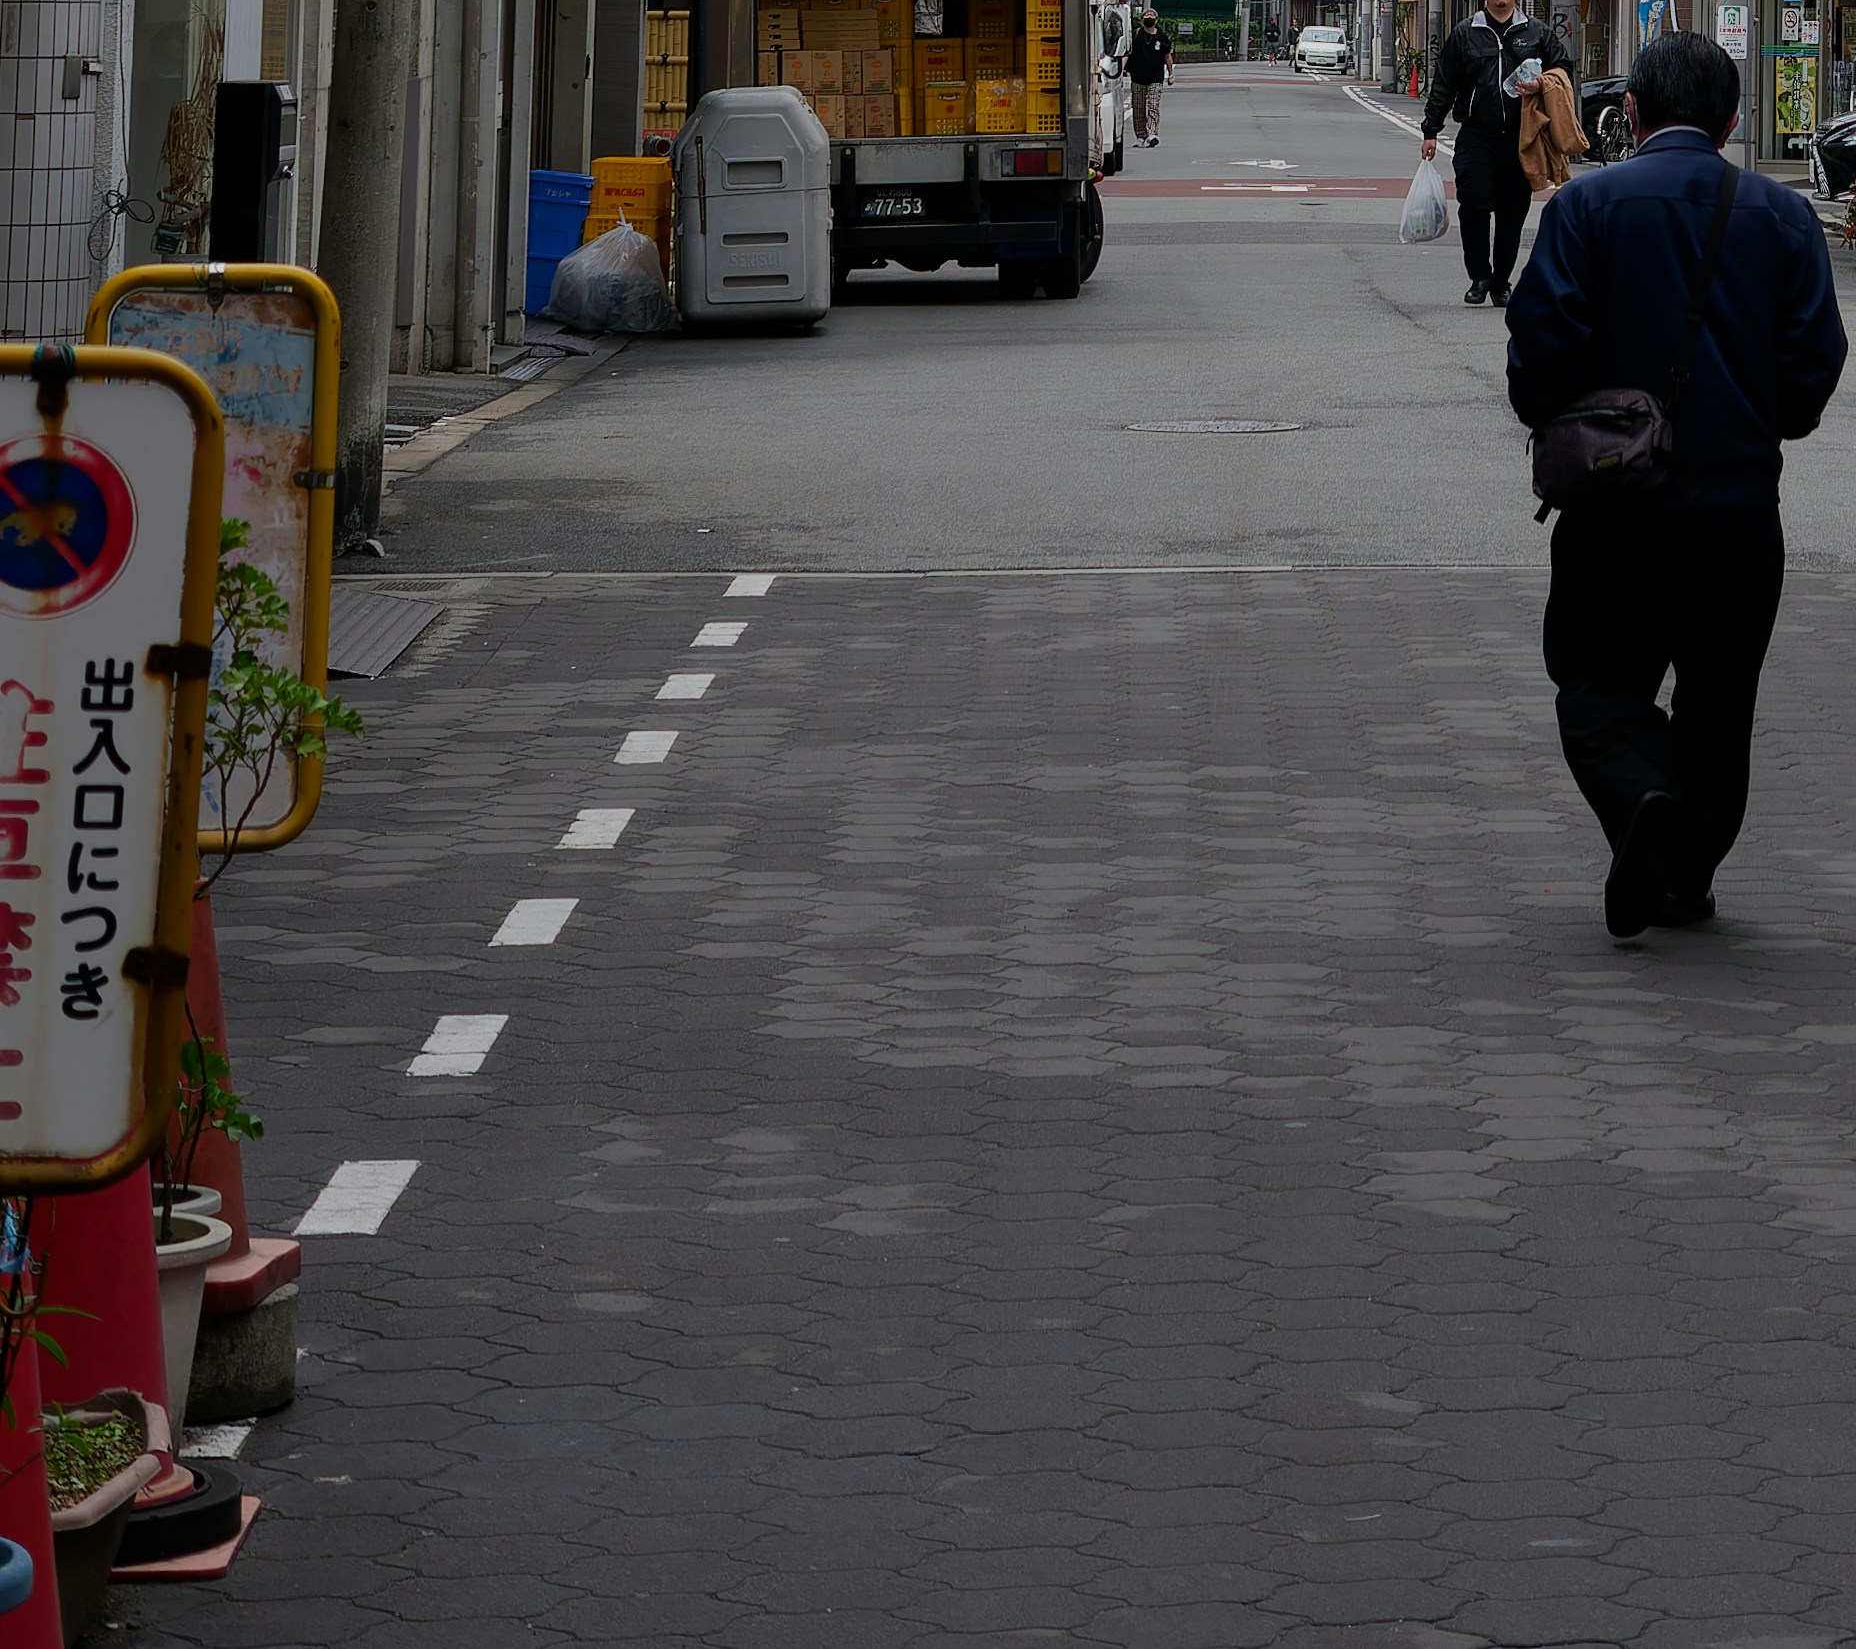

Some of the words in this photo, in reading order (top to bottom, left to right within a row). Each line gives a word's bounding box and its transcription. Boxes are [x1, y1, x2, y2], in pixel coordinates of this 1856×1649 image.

[875, 197, 923, 216] 77-53
[60, 656, 135, 1021] 出入口につき
